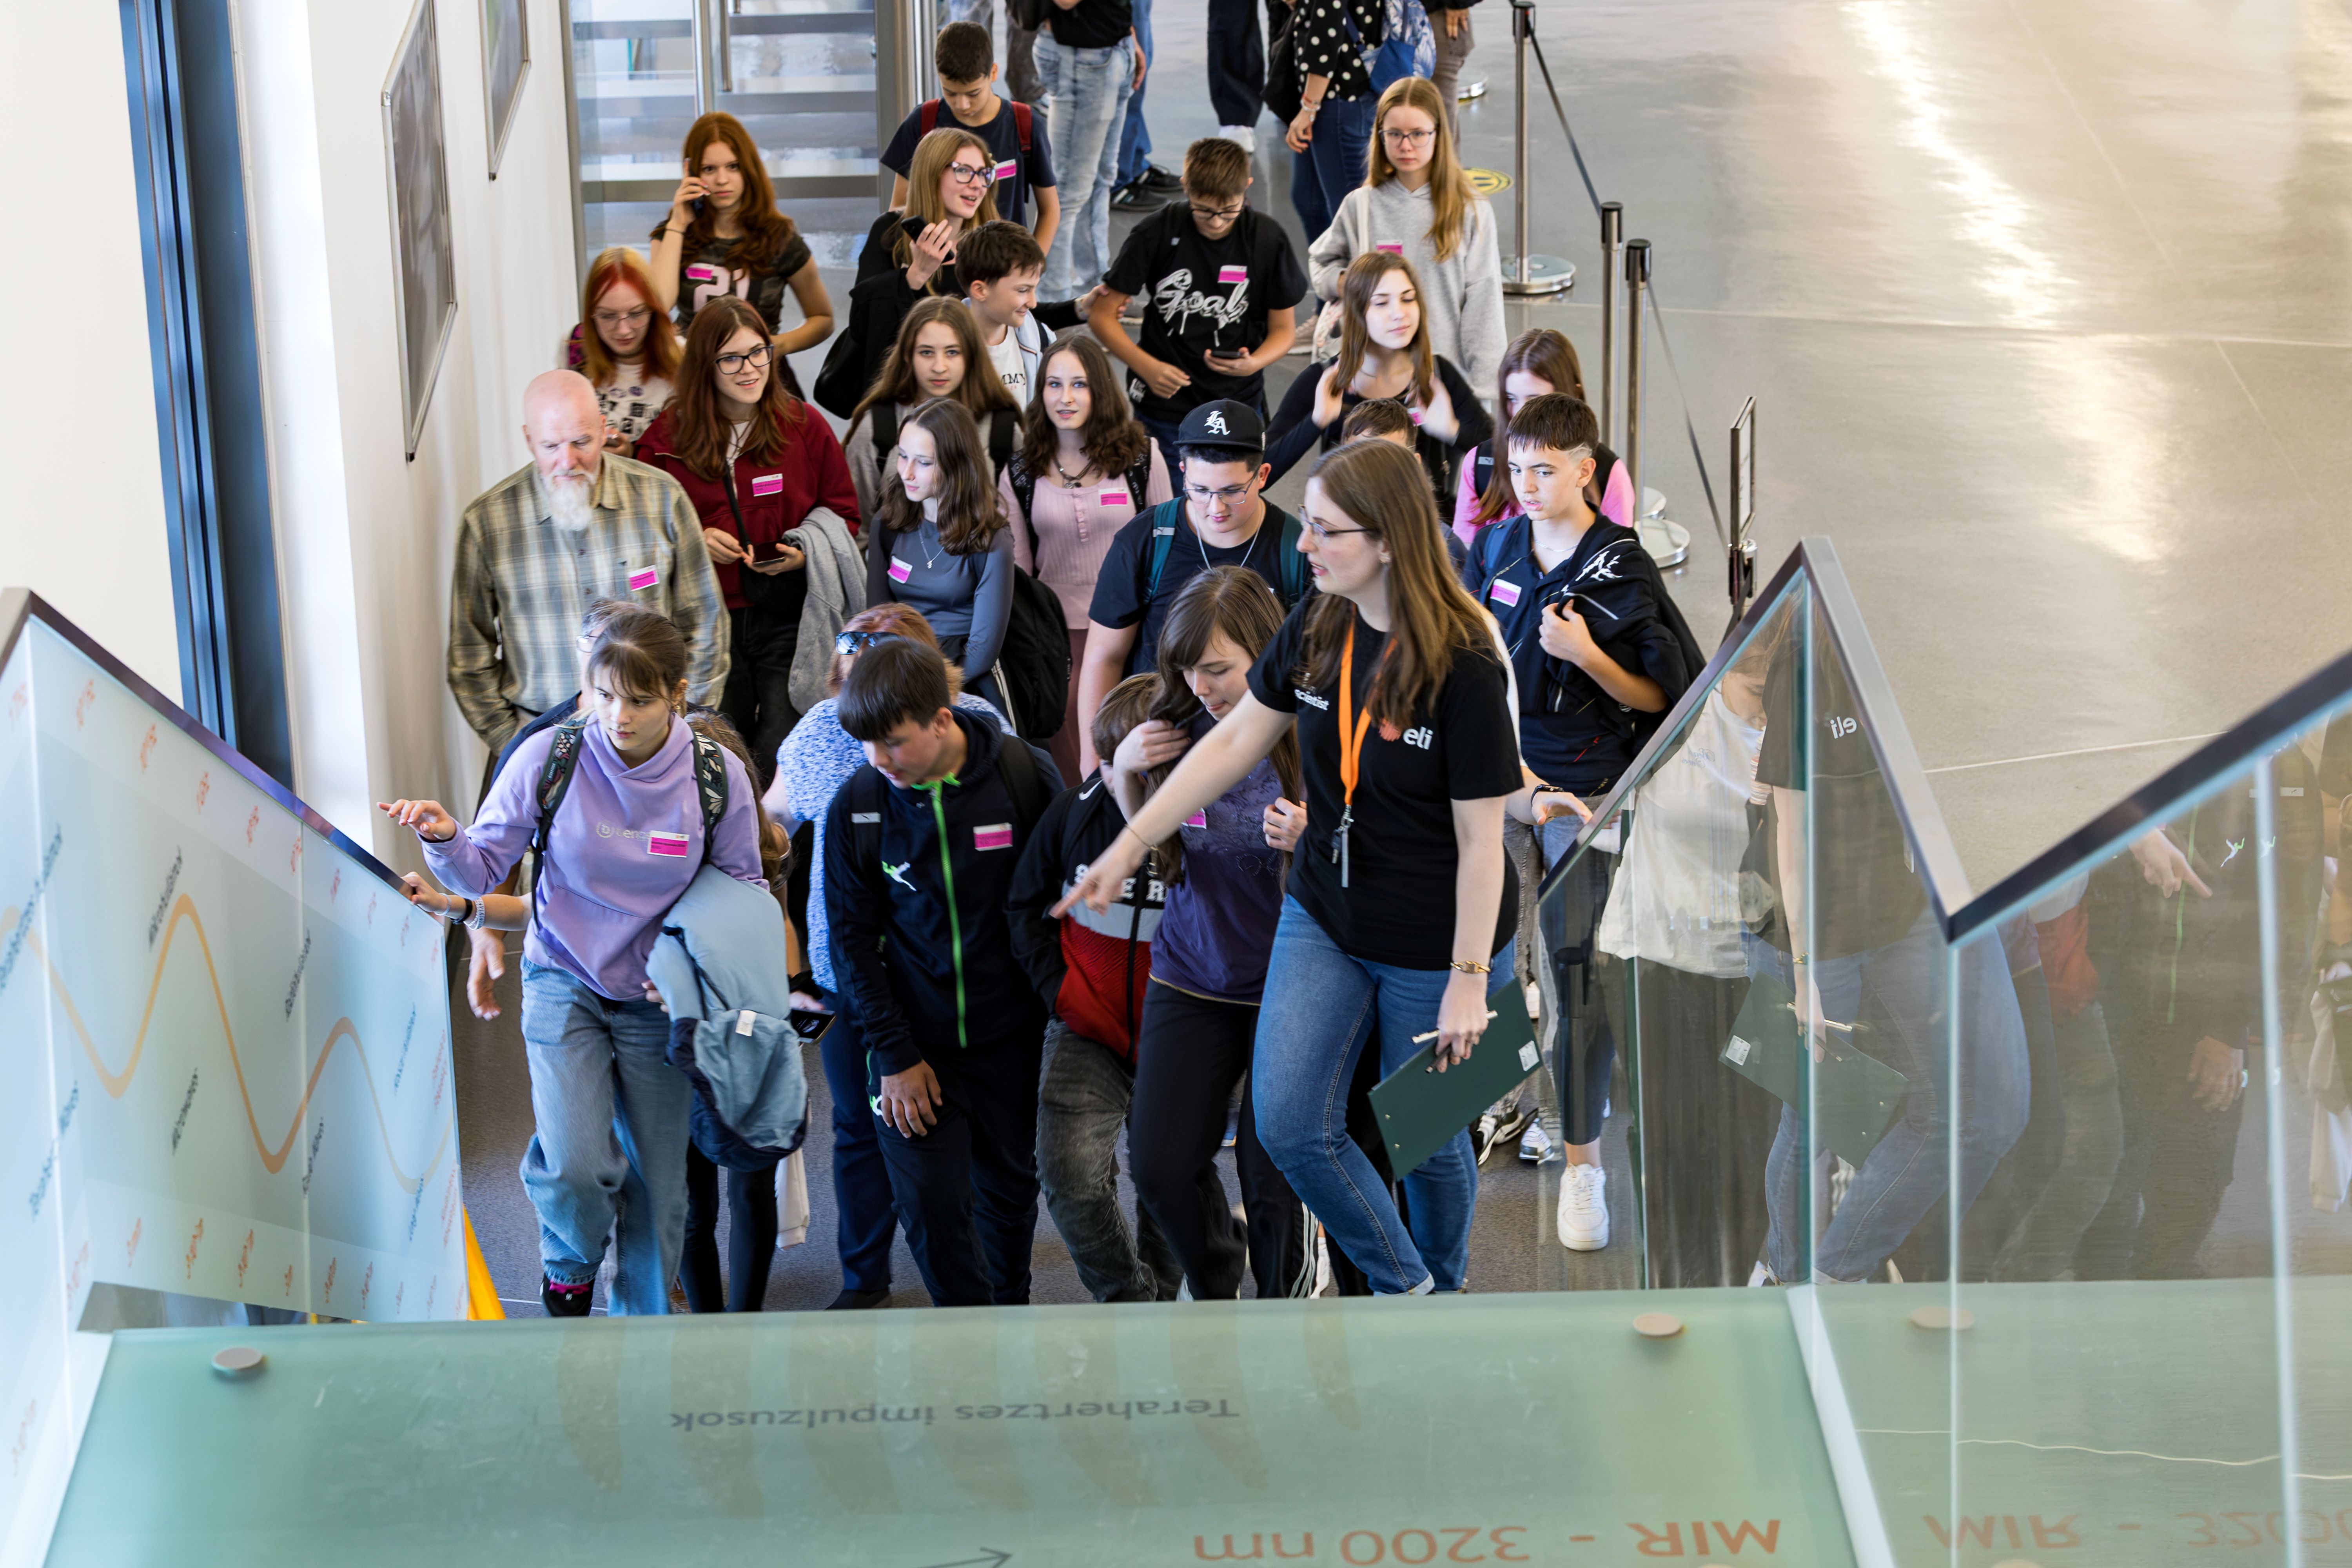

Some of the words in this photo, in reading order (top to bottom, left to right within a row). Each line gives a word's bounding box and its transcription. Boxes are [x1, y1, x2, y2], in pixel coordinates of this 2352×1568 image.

[1204, 410, 1230, 436] LA
[1403, 726, 1434, 750] eli
[669, 1403, 938, 1432] impulzusok
[955, 1399, 1240, 1420] Terahertzes
[1194, 1532, 1314, 1561] nm
[1339, 1526, 1530, 1566] 3200
[1624, 1519, 1781, 1557] MIR
